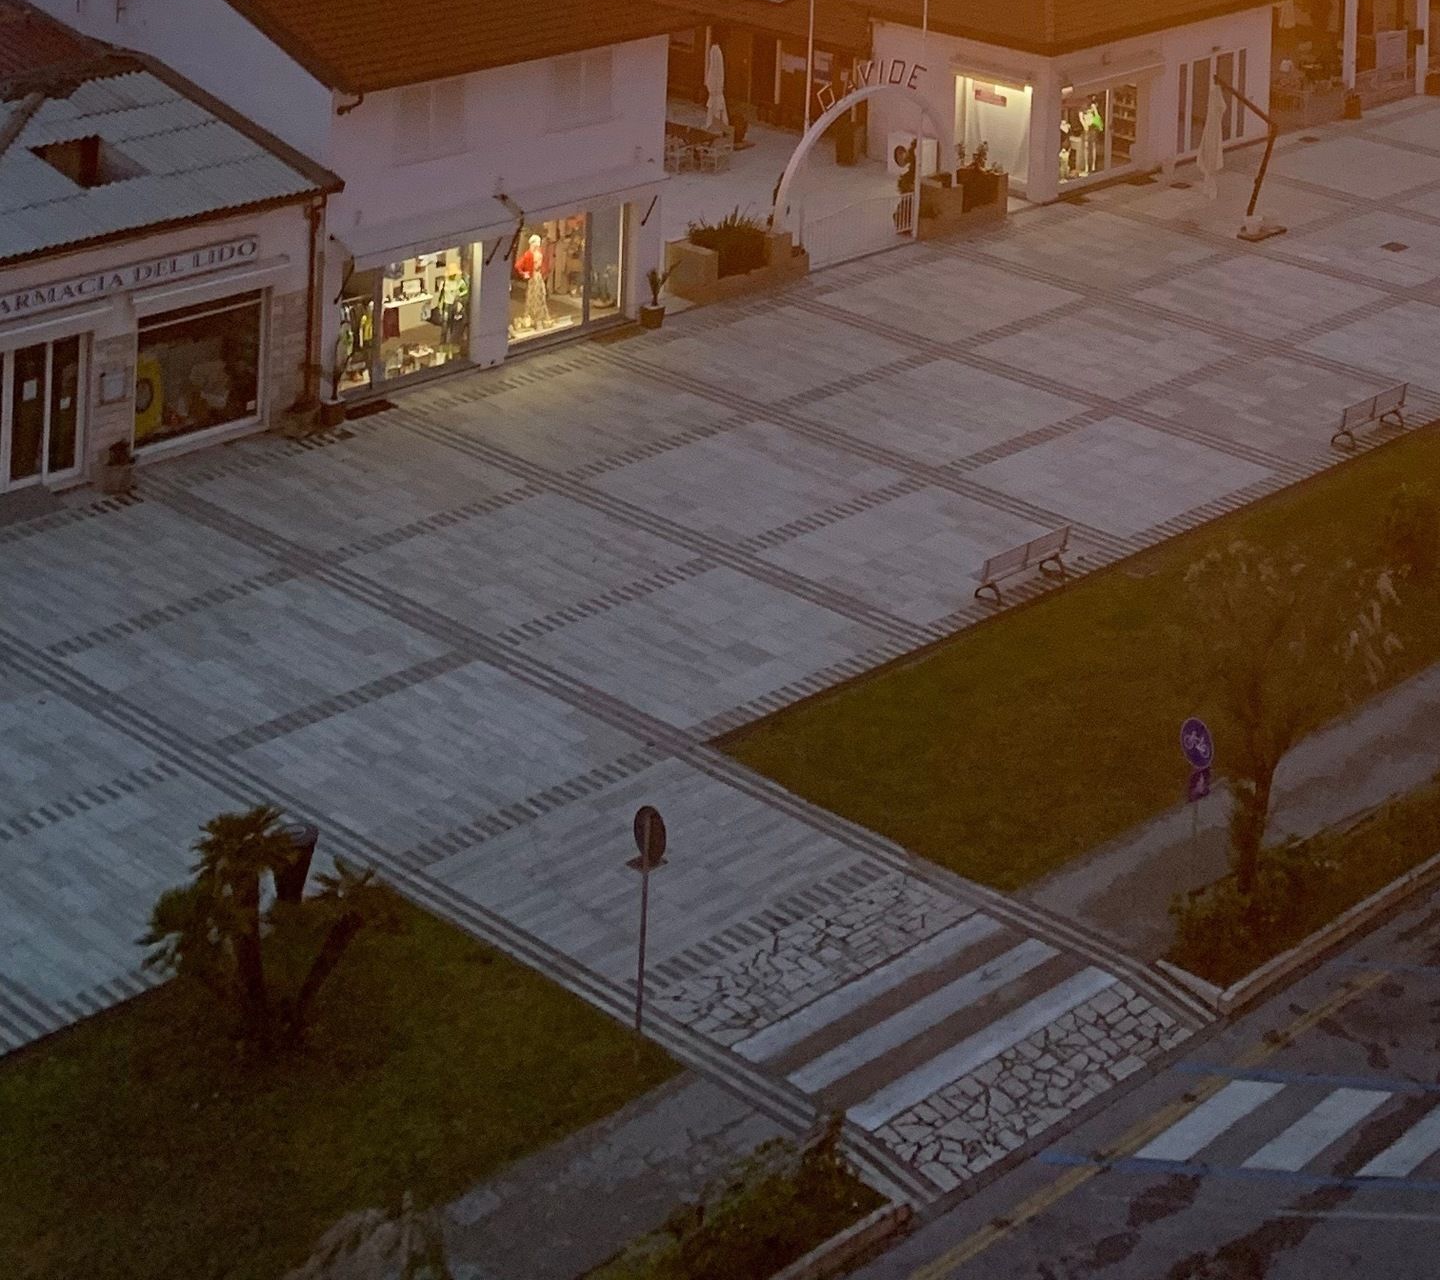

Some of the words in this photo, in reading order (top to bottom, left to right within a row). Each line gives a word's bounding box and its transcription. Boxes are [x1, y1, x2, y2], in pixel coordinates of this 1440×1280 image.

[0, 274, 124, 314] ARMACIA
[134, 259, 185, 283] DEL
[192, 241, 258, 269] LIDO
